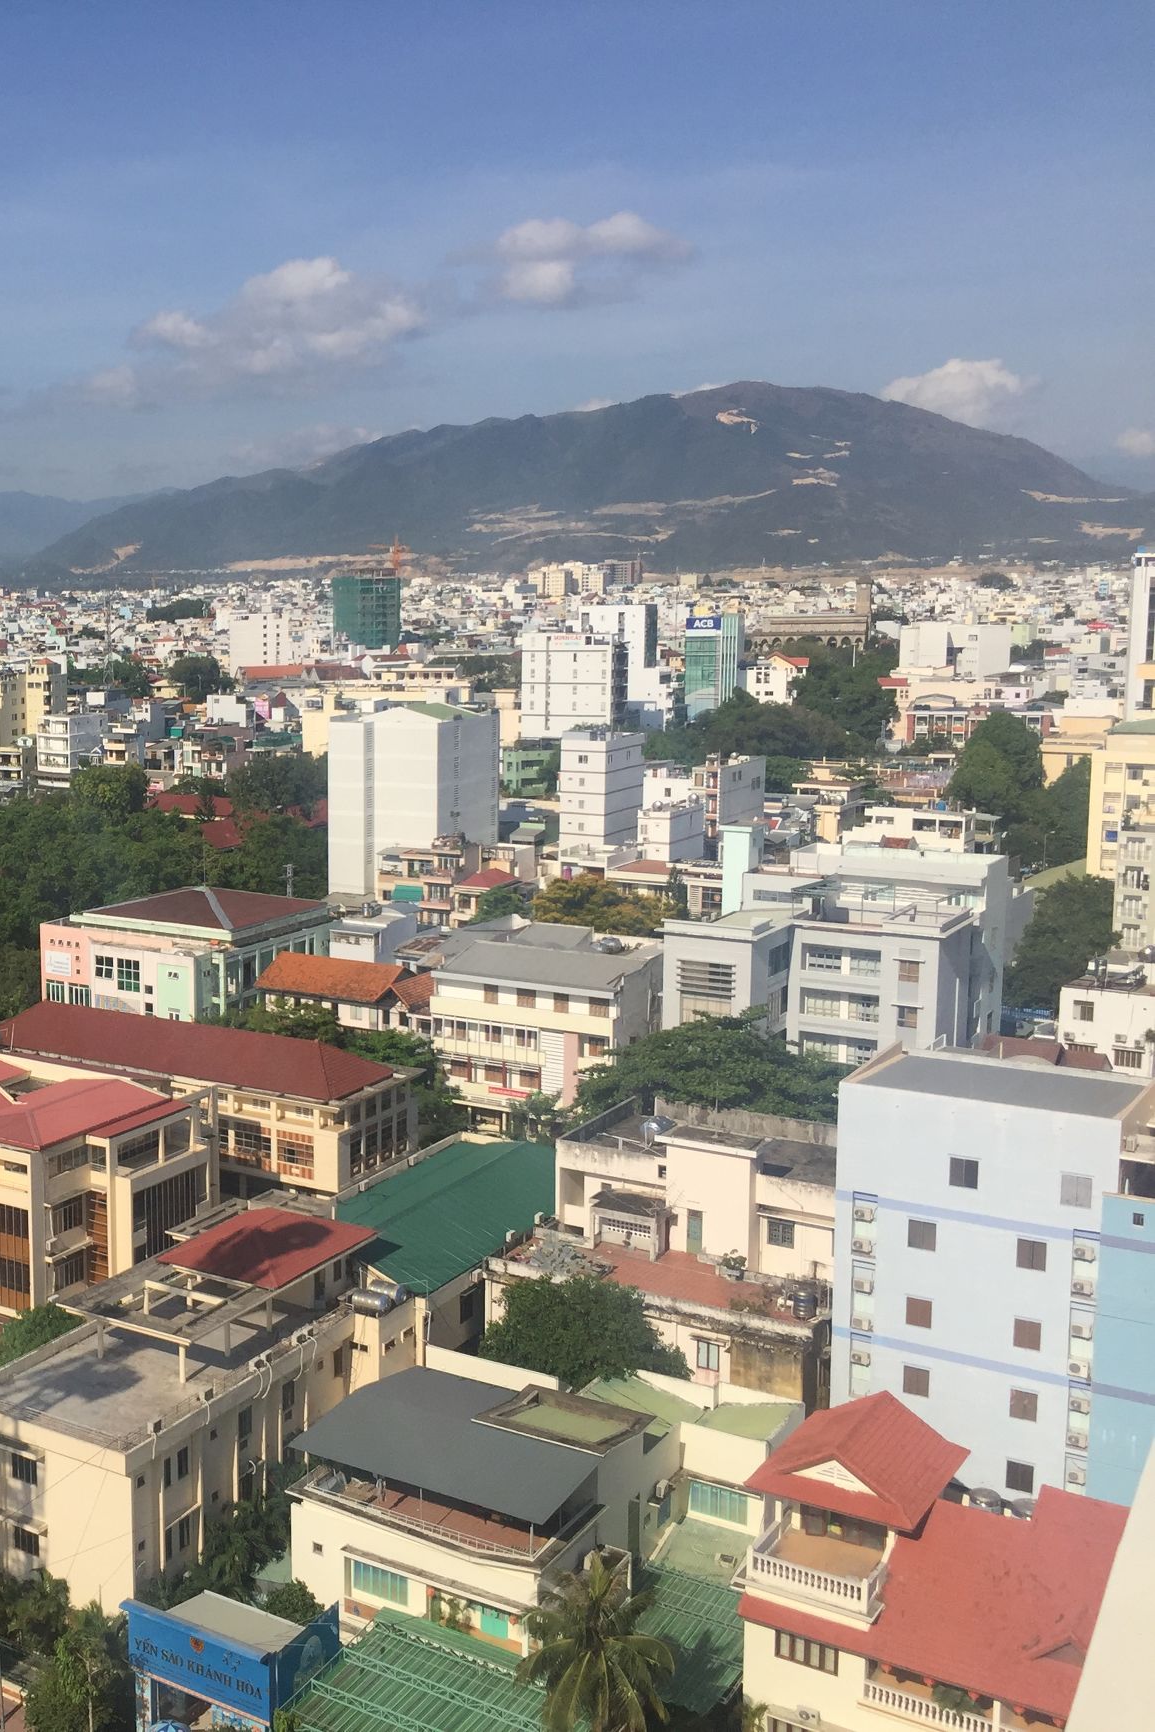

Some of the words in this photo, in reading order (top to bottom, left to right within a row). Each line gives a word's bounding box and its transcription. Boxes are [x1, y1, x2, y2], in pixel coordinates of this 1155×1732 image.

[693, 619, 714, 628] ACB
[161, 1648, 184, 1668] SÀO
[187, 1659, 232, 1688] KHÁNH
[236, 1678, 263, 1700] HÒA
